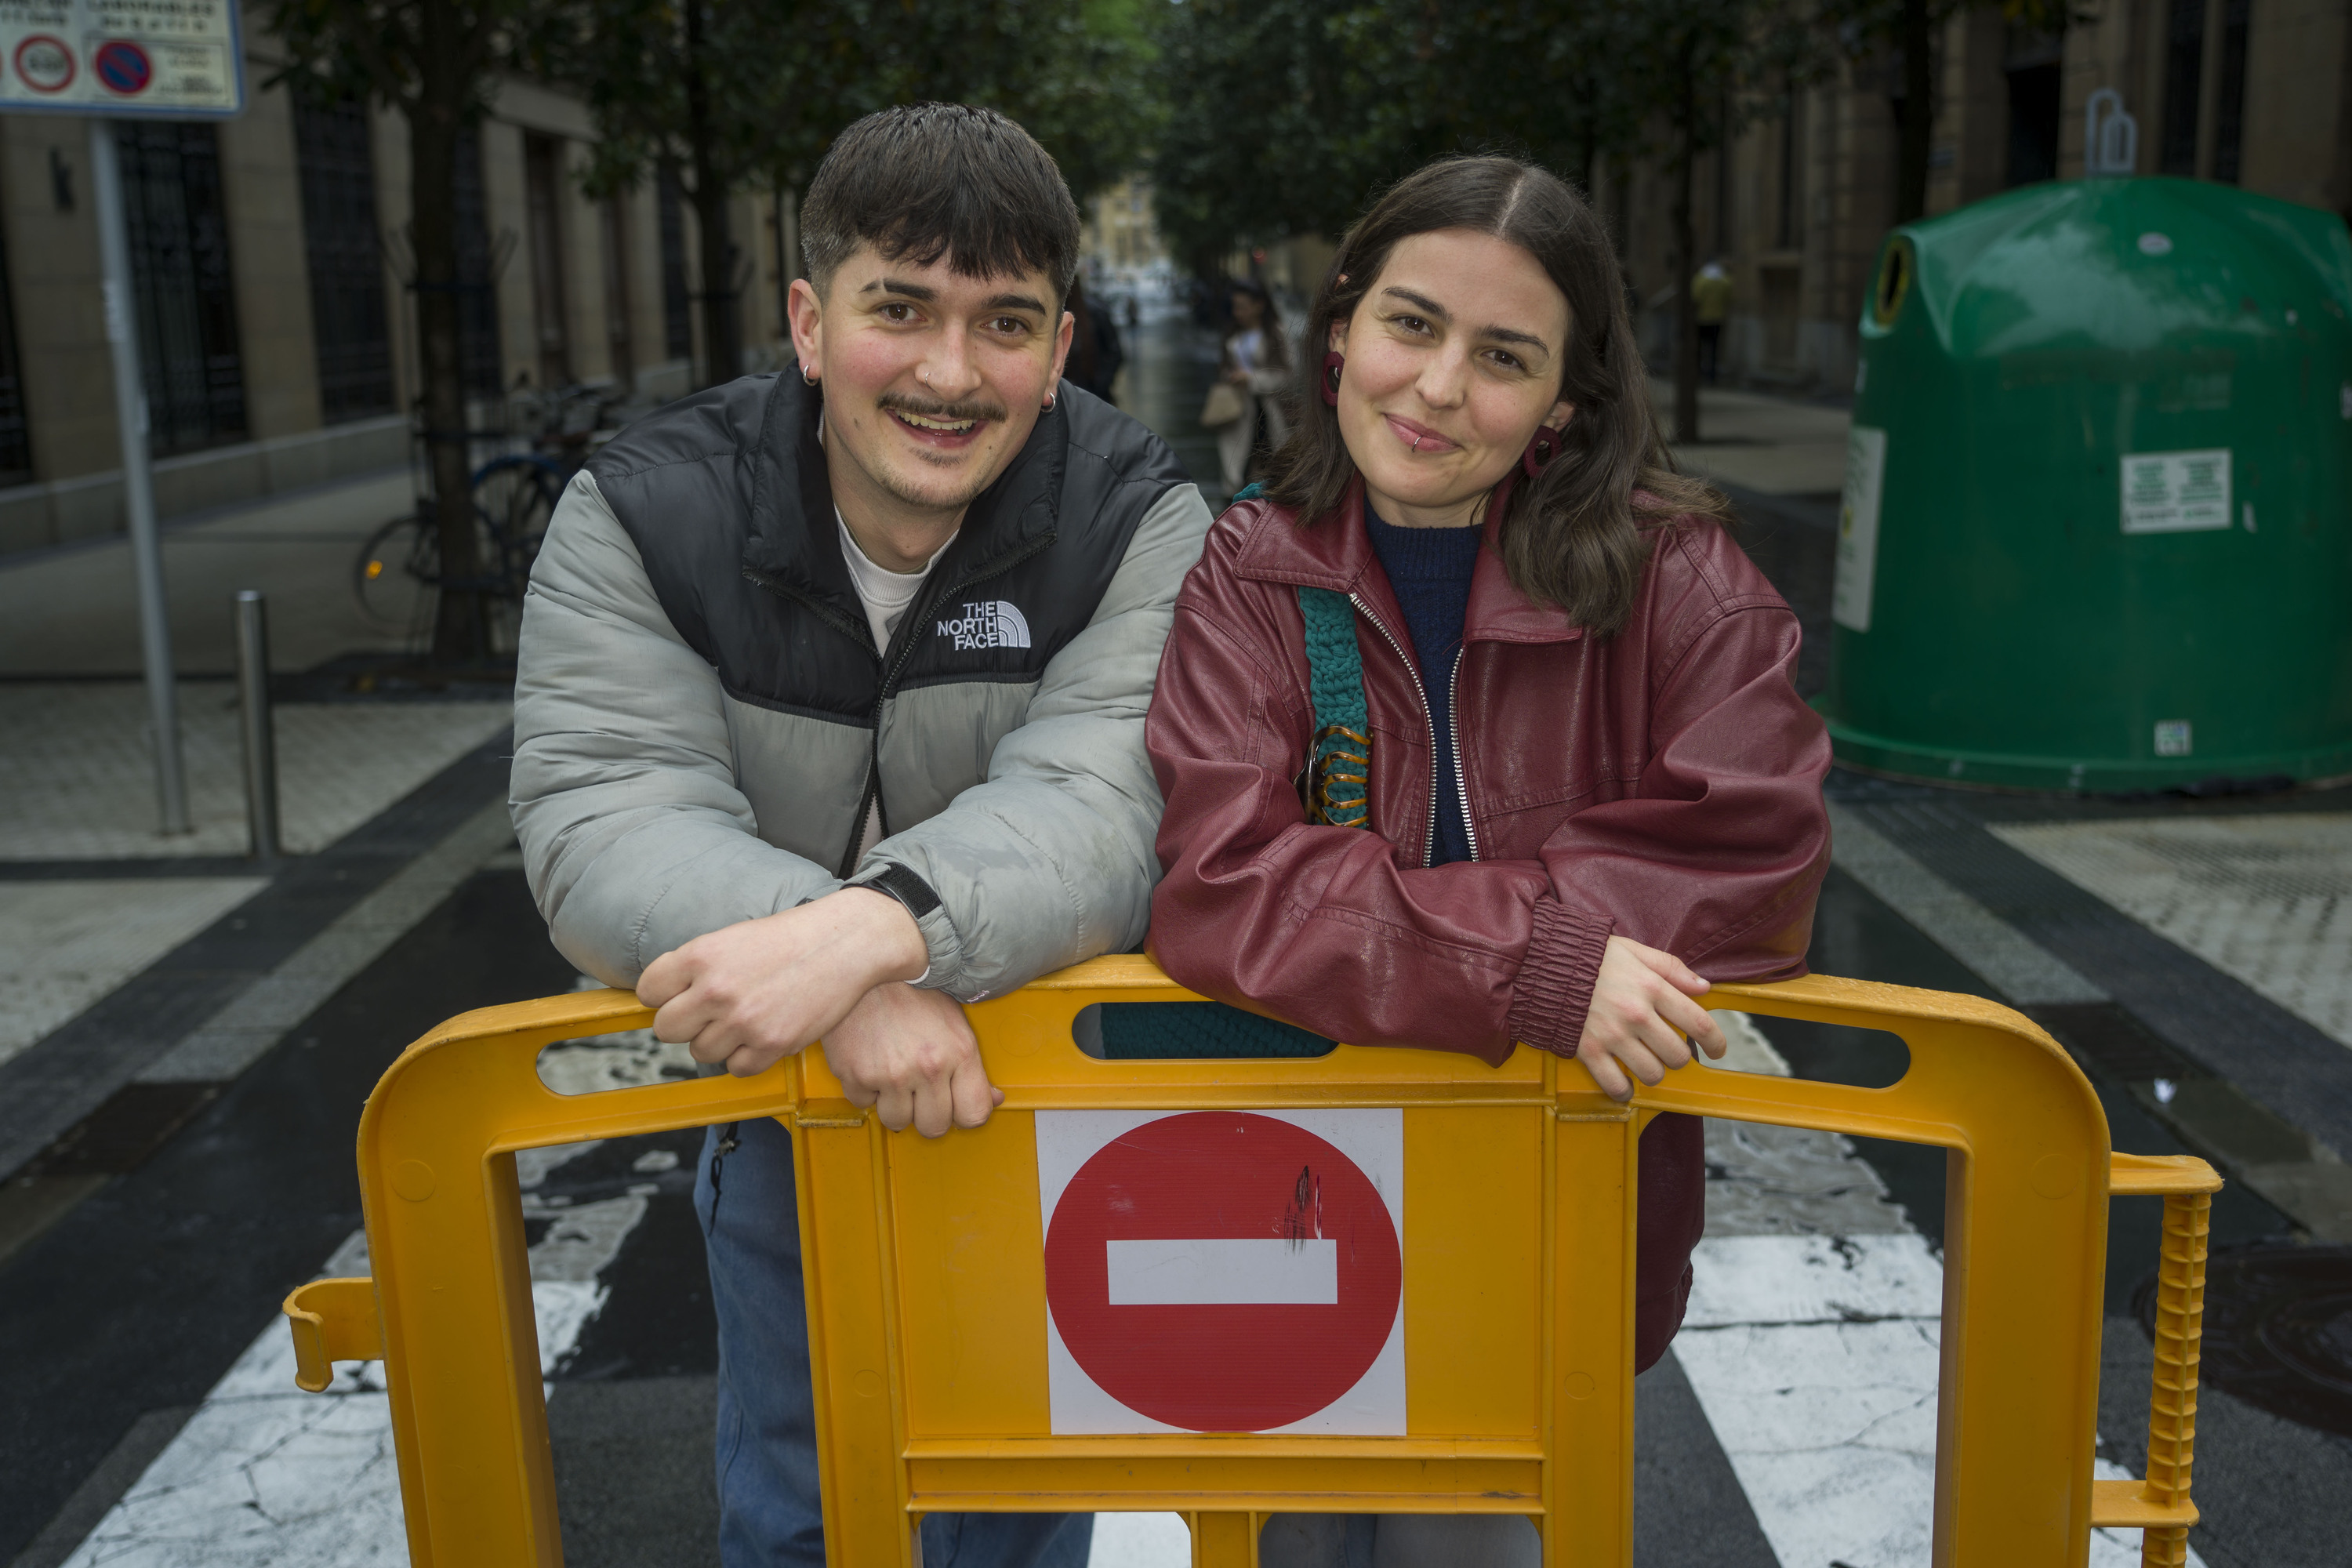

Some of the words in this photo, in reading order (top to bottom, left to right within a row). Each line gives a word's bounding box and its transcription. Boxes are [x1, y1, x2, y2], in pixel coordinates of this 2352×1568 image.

[963, 601, 996, 619] THE
[937, 616, 997, 637] NORTH
[954, 632, 999, 651] FACE
